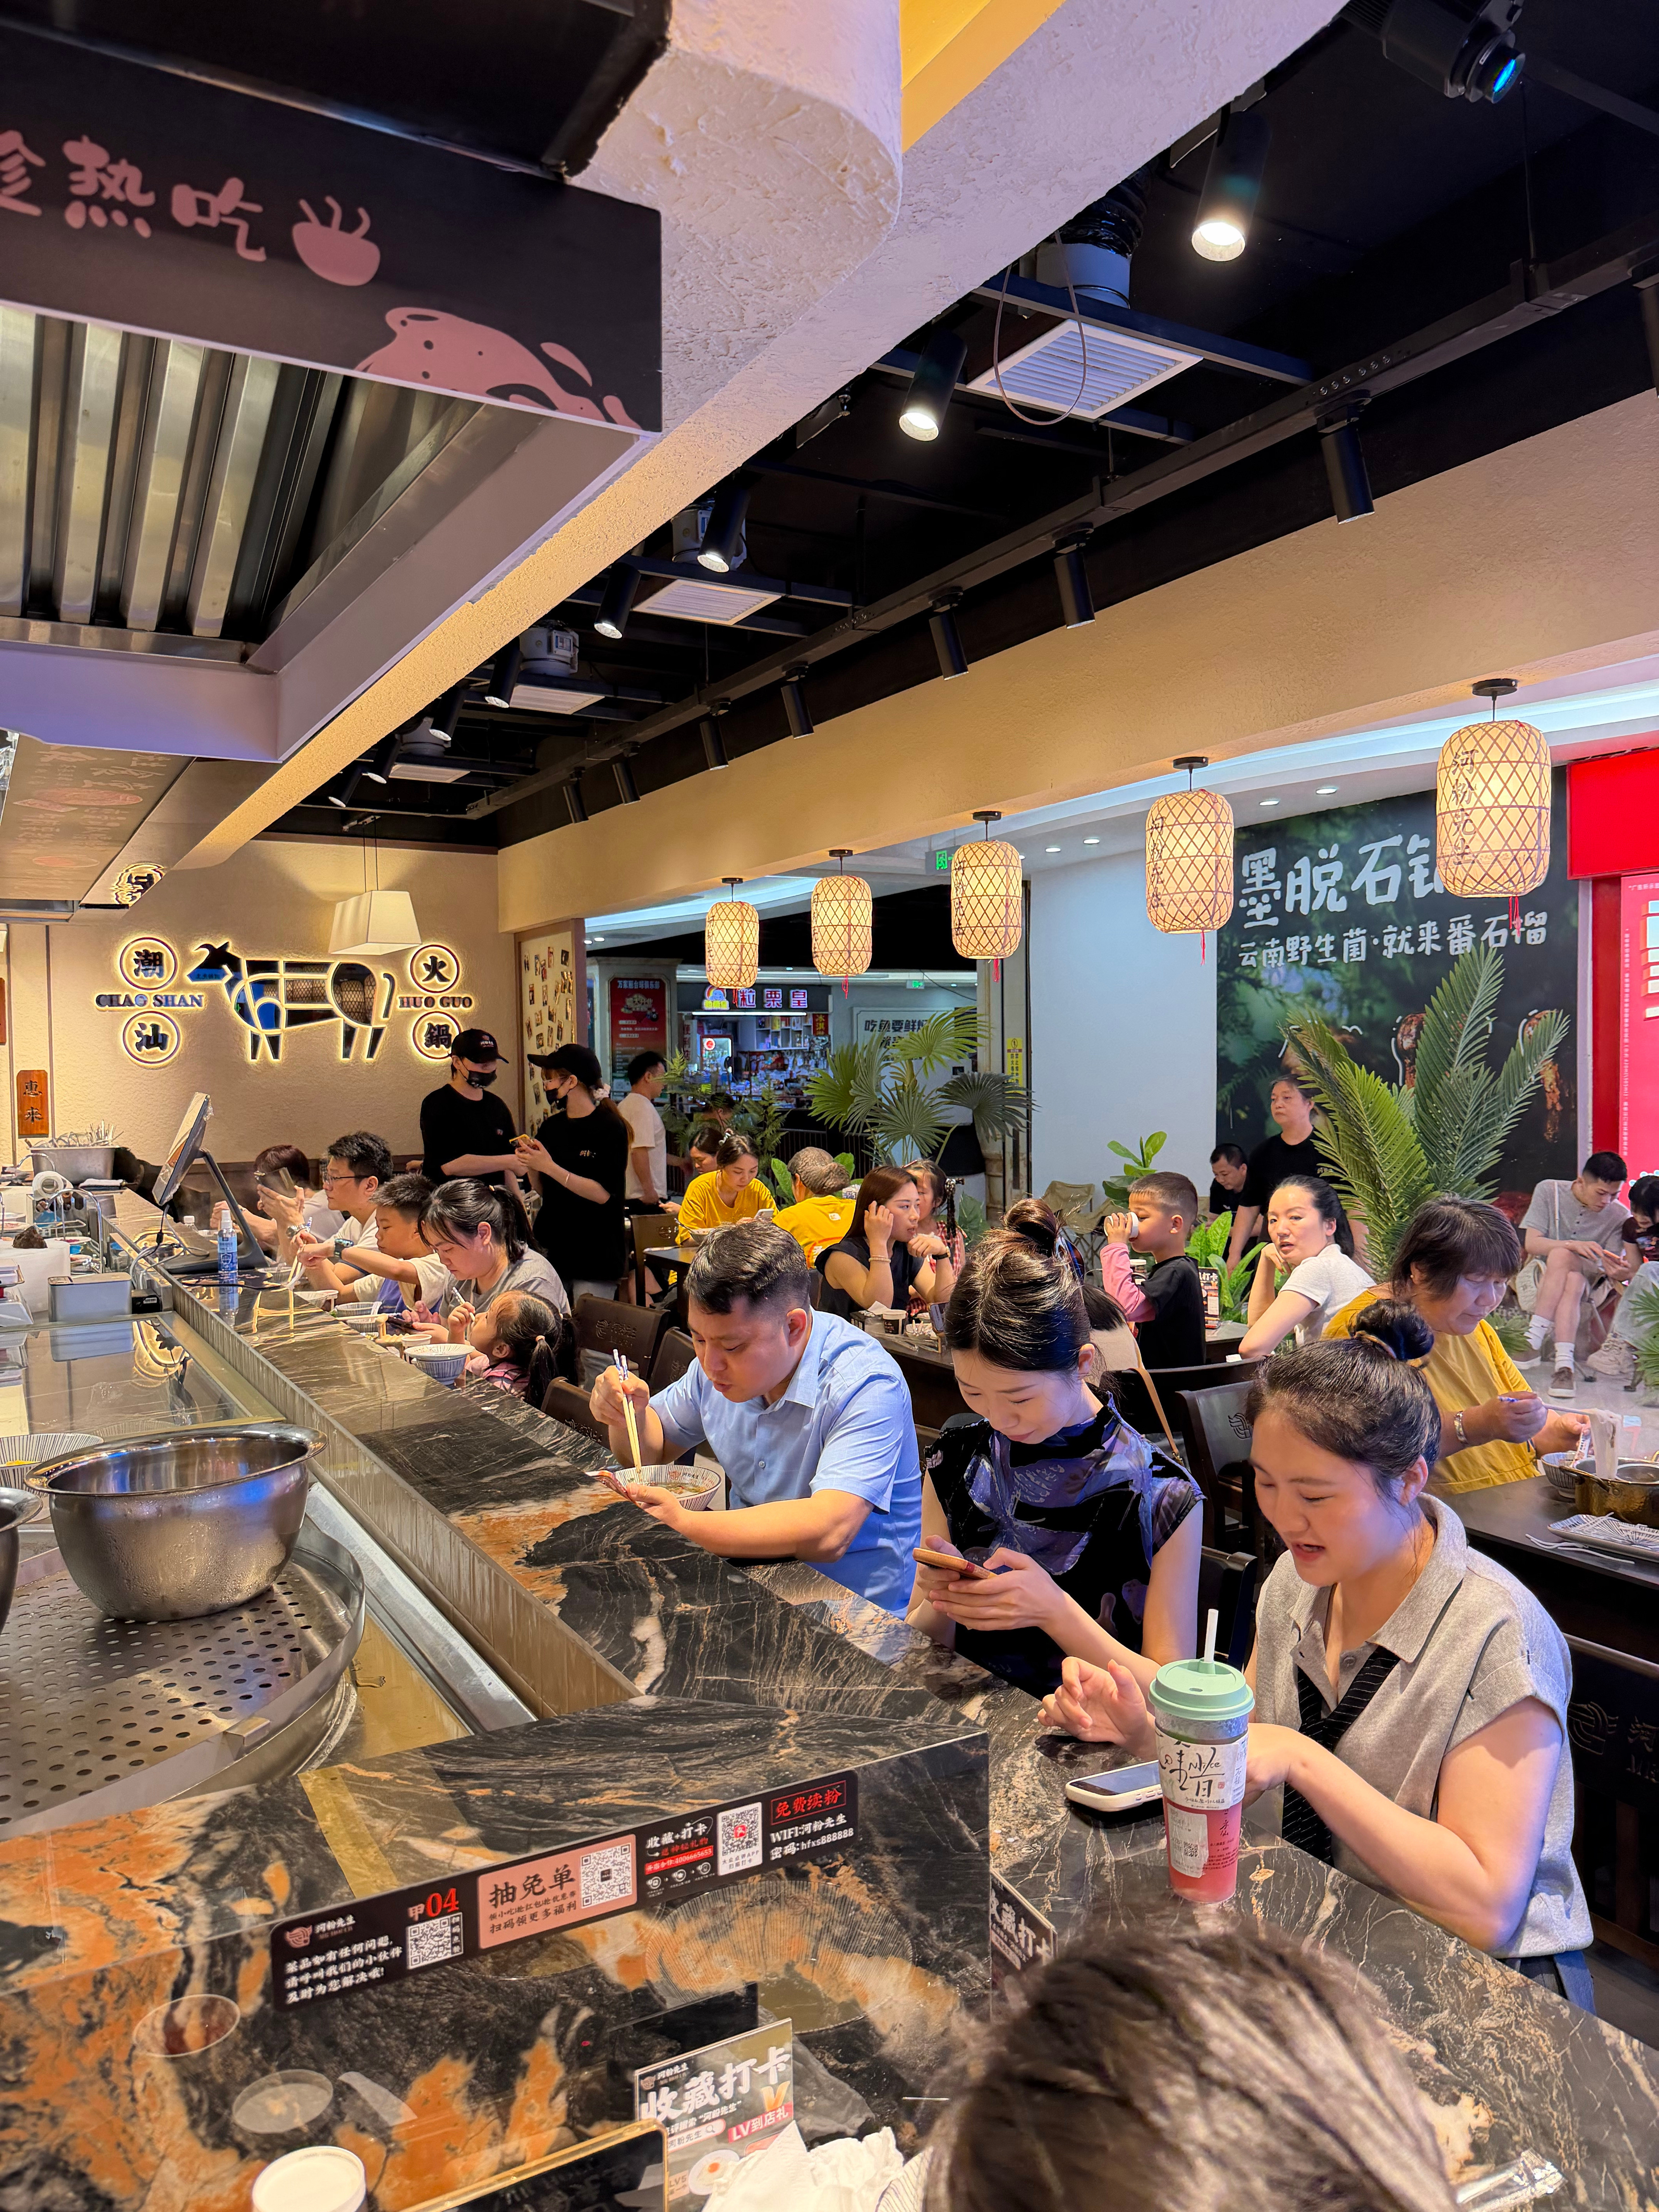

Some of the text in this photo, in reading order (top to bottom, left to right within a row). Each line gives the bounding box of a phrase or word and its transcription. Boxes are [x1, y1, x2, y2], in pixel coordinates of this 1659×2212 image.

[1452, 749, 1479, 865] 河粉先生
[133, 949, 165, 979] 潮
[422, 955, 450, 982] 火
[96, 994, 204, 1007] CHAO SHAN
[399, 996, 472, 1008] HUO GUO
[134, 1022, 169, 1052] 汕
[775, 1788, 842, 1819] 免费续粉
[769, 1813, 847, 1843] WIFI:河粉先生
[770, 1828, 854, 1861] 密码:hfxs888888
[489, 1863, 576, 1909] 抽免单
[489, 1900, 577, 1934] 扫码领更多福利
[285, 1946, 403, 1989] 请呼叫我们的小伙伴
[641, 2046, 791, 2122] 收藏打卡
[732, 2105, 790, 2141] LV到店礼
